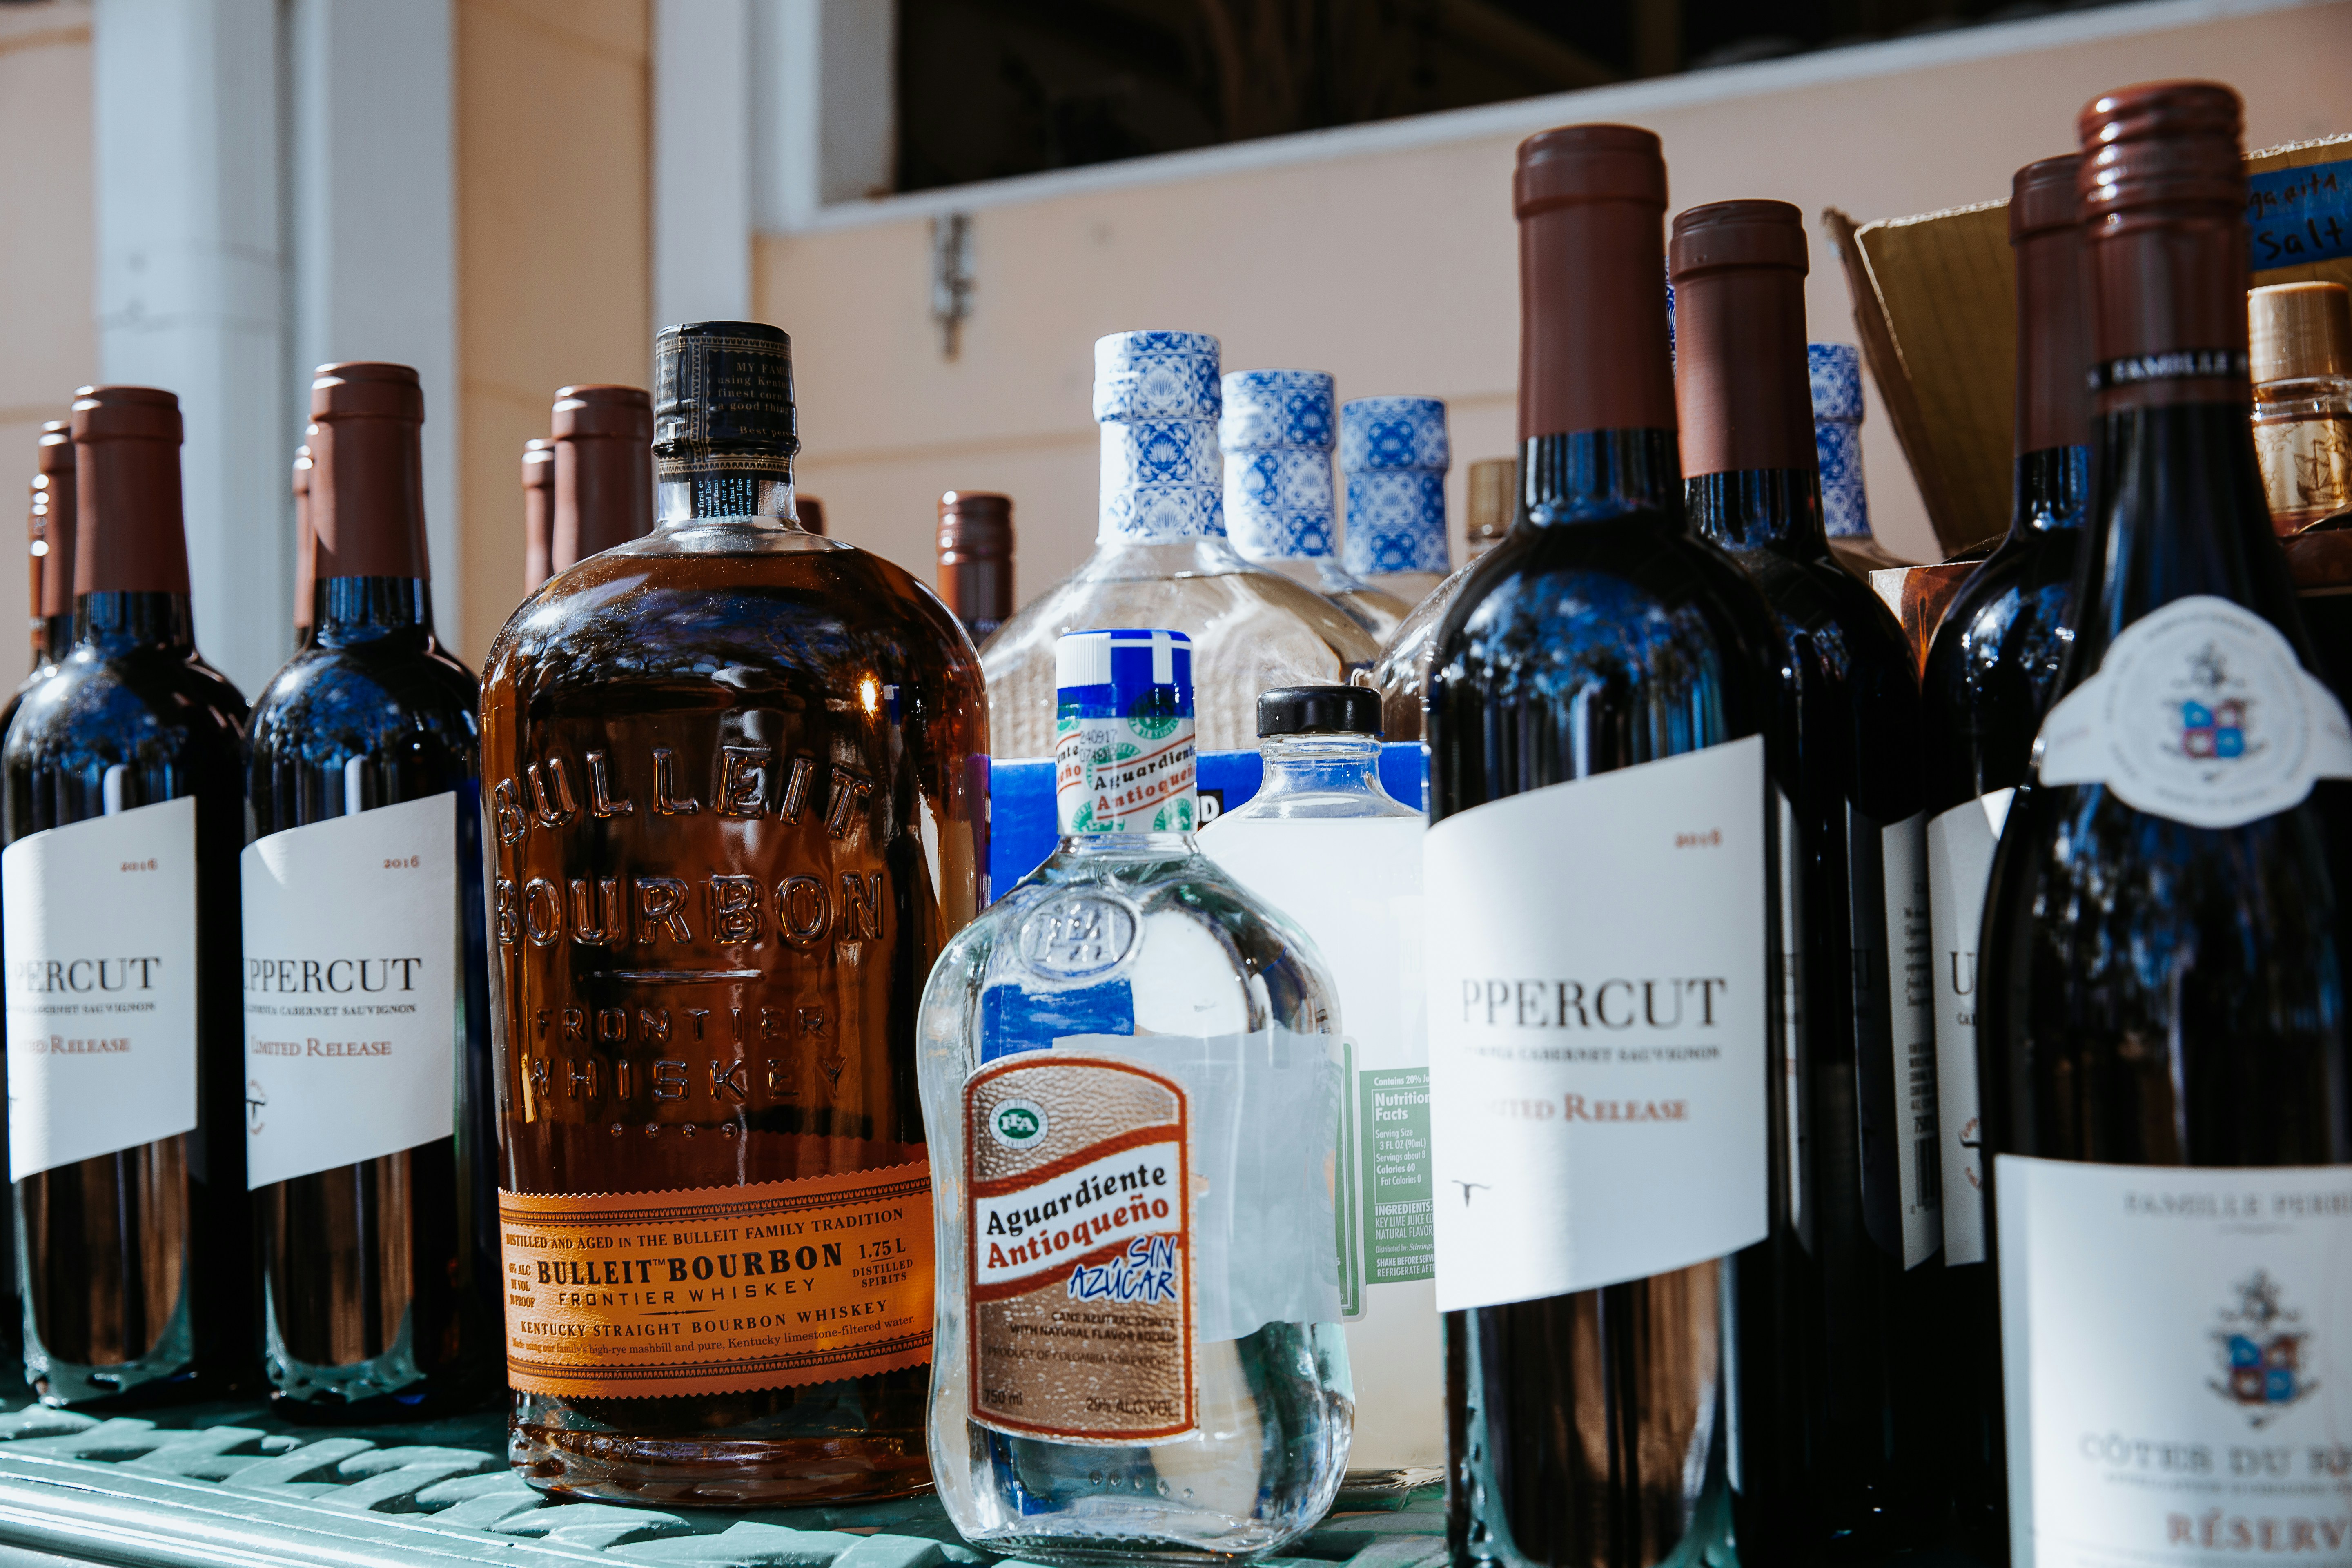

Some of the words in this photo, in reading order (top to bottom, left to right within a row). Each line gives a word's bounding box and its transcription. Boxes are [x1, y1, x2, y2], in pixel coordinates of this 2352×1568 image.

[2258, 216, 2344, 261] Salt
[736, 362, 755, 372] MY
[718, 375, 751, 386] using
[718, 388, 755, 398] finest
[730, 401, 760, 411] good
[740, 425, 768, 435] Best
[494, 746, 874, 846] BULLEIT
[383, 854, 420, 869] 2016
[495, 869, 883, 947] BOURBON
[341, 1003, 416, 1016] SAUVIGNON
[536, 1007, 827, 1043] FRONTIER
[306, 1037, 392, 1057] RELEASE
[529, 1056, 847, 1101] WHISKEY
[1374, 1076, 1404, 1086] Contains
[1406, 1074, 1421, 1085] 20%
[1375, 1107, 1408, 1121] Facts
[1375, 1129, 1399, 1139] Serving
[1400, 1127, 1413, 1137] Size
[1379, 1141, 1384, 1151] 3
[1386, 1140, 1394, 1150] FL
[1395, 1140, 1404, 1149] OZ
[1405, 1137, 1426, 1151] (90mL)
[1376, 1153, 1403, 1163] Servings
[1404, 1151, 1421, 1160] about
[1422, 1149, 1426, 1159] 8
[1376, 1164, 1405, 1174] Calories
[1407, 1162, 1416, 1172] 60
[1381, 1176, 1391, 1186] Fat
[1392, 1175, 1417, 1185] Calories
[1417, 1174, 1421, 1183] 0
[987, 1163, 1167, 1236] Aguardiente
[1375, 1201, 1433, 1216] INGREDIENTS:
[1376, 1216, 1388, 1228] KEY
[1390, 1215, 1406, 1227] LIME
[1407, 1213, 1425, 1226] JUICE
[506, 1233, 547, 1248] DISTILLED
[552, 1238, 572, 1249] AND
[578, 1236, 613, 1249] AGED
[619, 1237, 631, 1247] IN
[637, 1234, 667, 1247] THE
[673, 1229, 739, 1245] BULLEIT
[746, 1222, 805, 1239] FAMILY
[811, 1208, 903, 1232] TRADITION
[987, 1193, 1169, 1269] Antioqueño
[1376, 1227, 1407, 1240] NATURAL
[859, 1239, 891, 1259] 1.75
[895, 1238, 906, 1253] L
[1129, 1236, 1175, 1269] SIN
[1376, 1244, 1400, 1254] Distributed
[667, 1242, 842, 1282] BOURBON
[853, 1258, 913, 1278] DISTILLED
[1376, 1257, 1396, 1268] SHAKE
[1397, 1255, 1419, 1266] BEFORE
[518, 1265, 531, 1276] ALC
[1377, 1265, 1420, 1278] REFRIGERATE
[518, 1280, 530, 1292] VOL
[862, 1272, 907, 1288] SPIRITS
[1070, 1258, 1175, 1301] AZÚCAR
[559, 1291, 675, 1307] FRONTIER
[689, 1278, 815, 1302] WHISKEY
[521, 1321, 586, 1337] KENTUCKY
[593, 1322, 681, 1337] STRAIGHT
[691, 1314, 786, 1333] BOURBON
[797, 1299, 887, 1323] WHISKEY
[1051, 1311, 1079, 1323] CANE
[589, 1343, 627, 1356] high-rye
[629, 1341, 672, 1354] mashbill
[675, 1341, 695, 1352] and
[698, 1341, 726, 1353] pure,
[728, 1335, 780, 1348] Kentucky
[784, 1319, 882, 1343] limestone-filtered
[884, 1315, 915, 1328] water.
[1010, 1324, 1038, 1335] WITH
[1040, 1325, 1089, 1339] NATURAL
[1092, 1328, 1133, 1341] FLAVOR
[988, 1348, 1034, 1359] PRODUCT
[1037, 1349, 1049, 1361] OF
[984, 1389, 1006, 1404] 750
